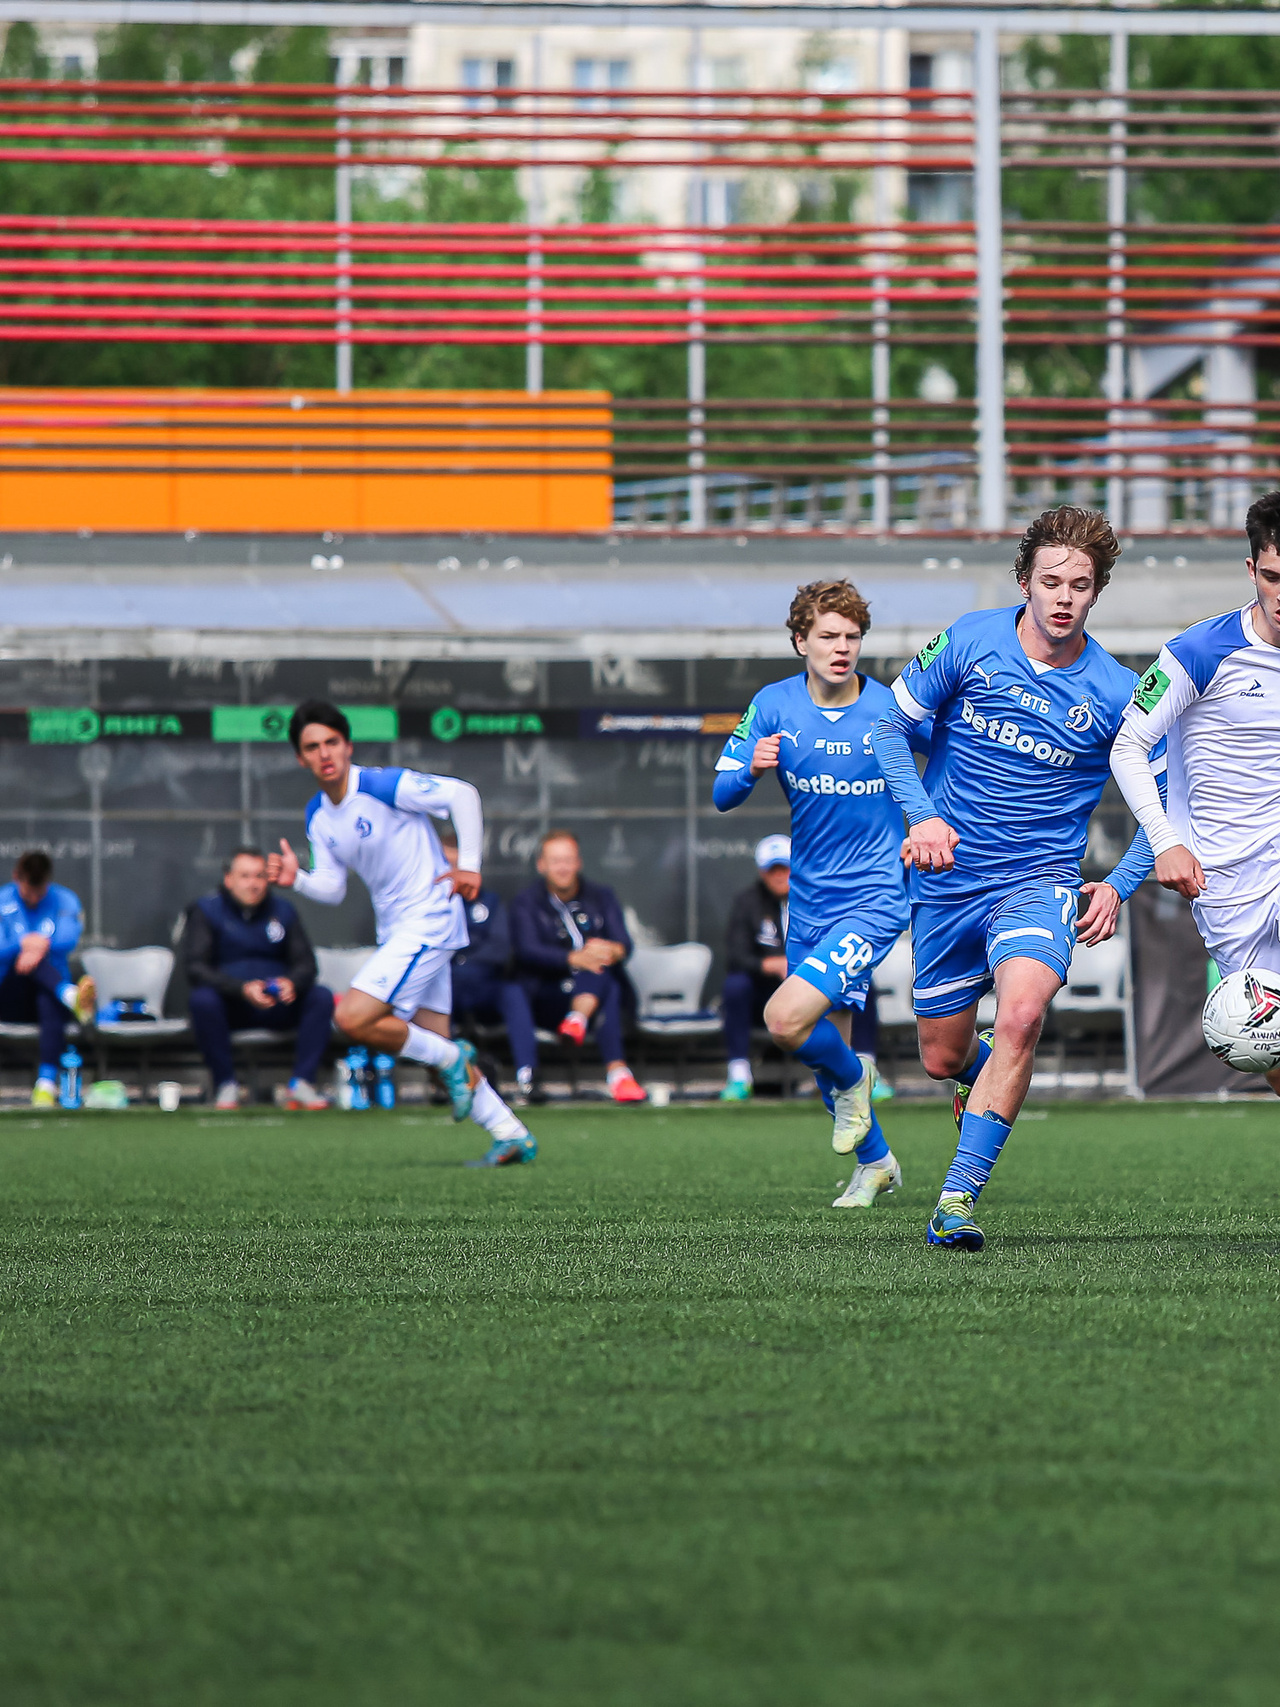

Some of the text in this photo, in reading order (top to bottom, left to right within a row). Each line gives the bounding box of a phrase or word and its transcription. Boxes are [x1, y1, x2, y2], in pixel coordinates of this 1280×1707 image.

[1020, 692, 1051, 715] ВТБ
[104, 714, 182, 736] ЛИГА
[961, 698, 1076, 767] BetBoom
[825, 741, 851, 756] ВТБ
[785, 770, 886, 796] BetBoom
[829, 932, 873, 977] 58
